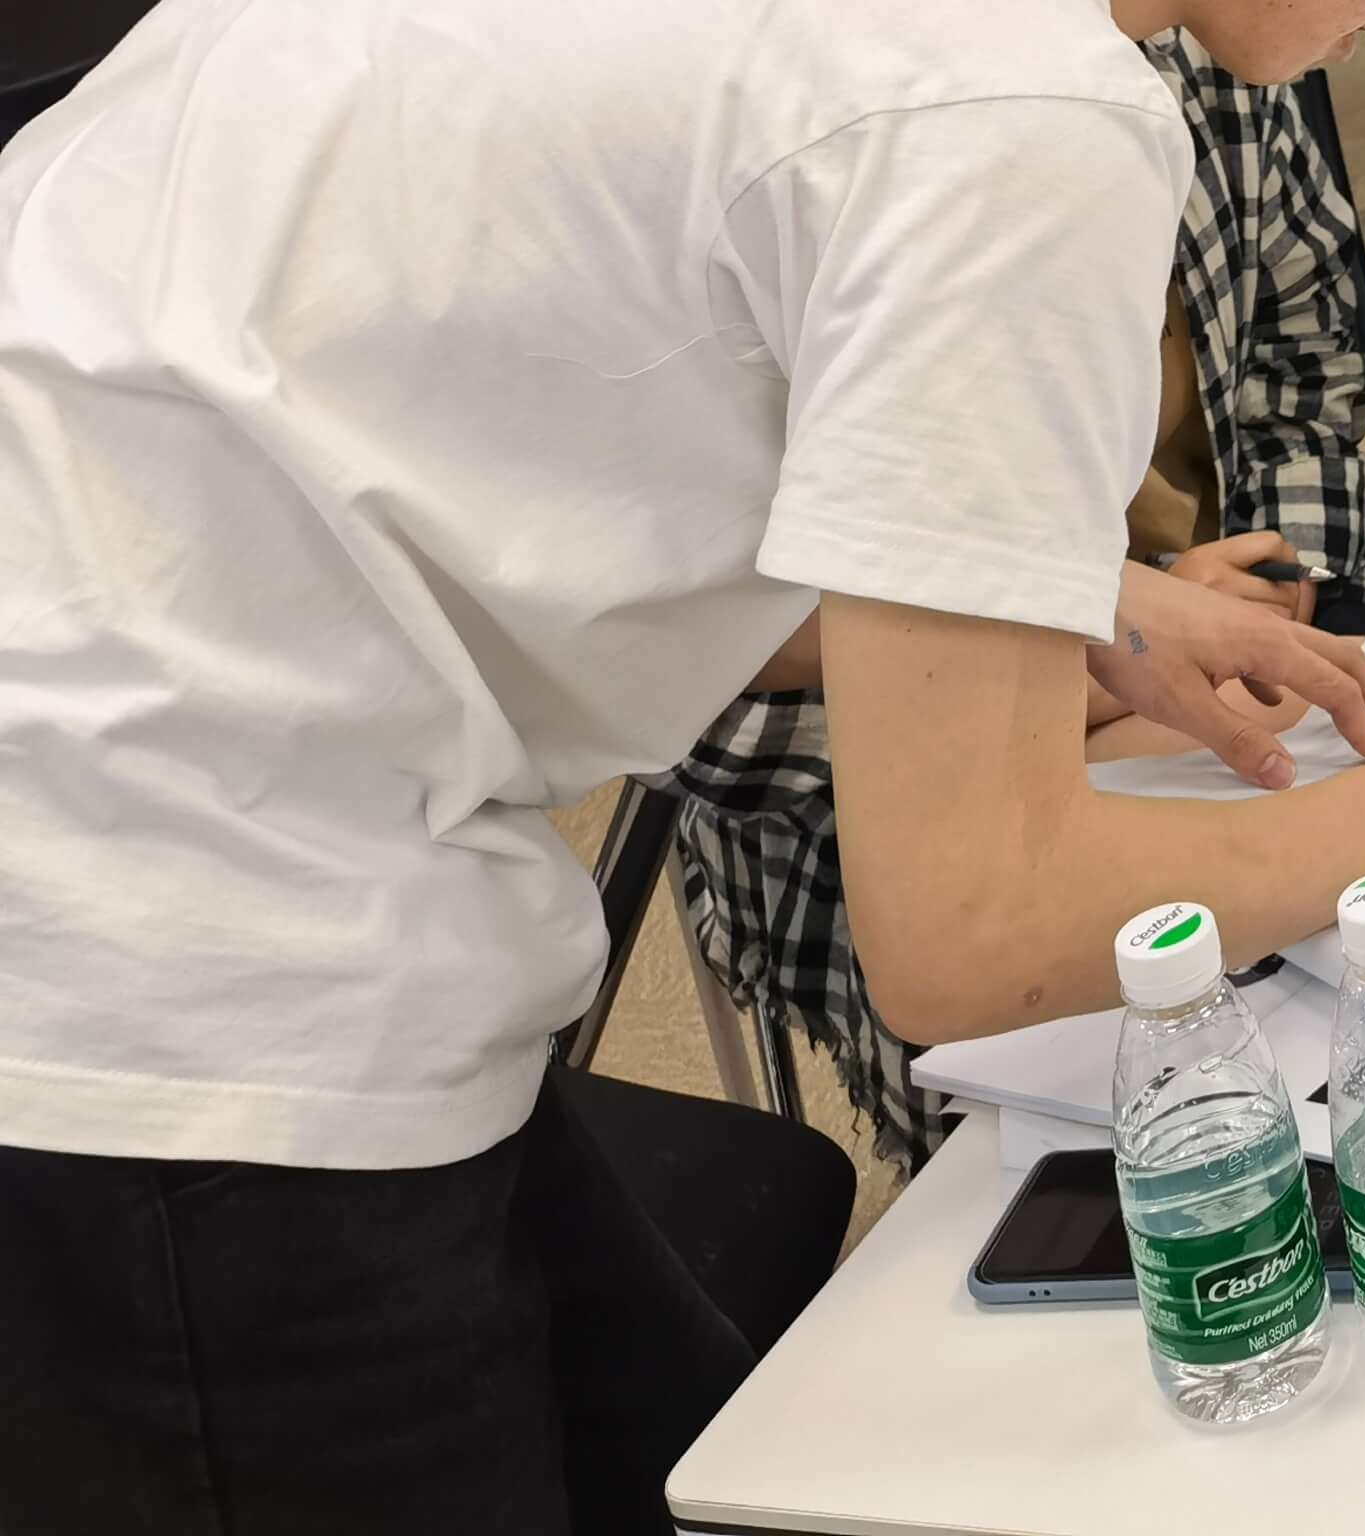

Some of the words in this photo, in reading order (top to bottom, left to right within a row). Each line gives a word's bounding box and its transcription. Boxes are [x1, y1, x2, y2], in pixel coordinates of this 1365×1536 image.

[1208, 1238, 1304, 1303] C'estbon
[1203, 1318, 1252, 1337] Purified
[1252, 1296, 1294, 1329] Drinking
[1248, 1334, 1269, 1353] Net
[1269, 1315, 1297, 1347] 350ml
